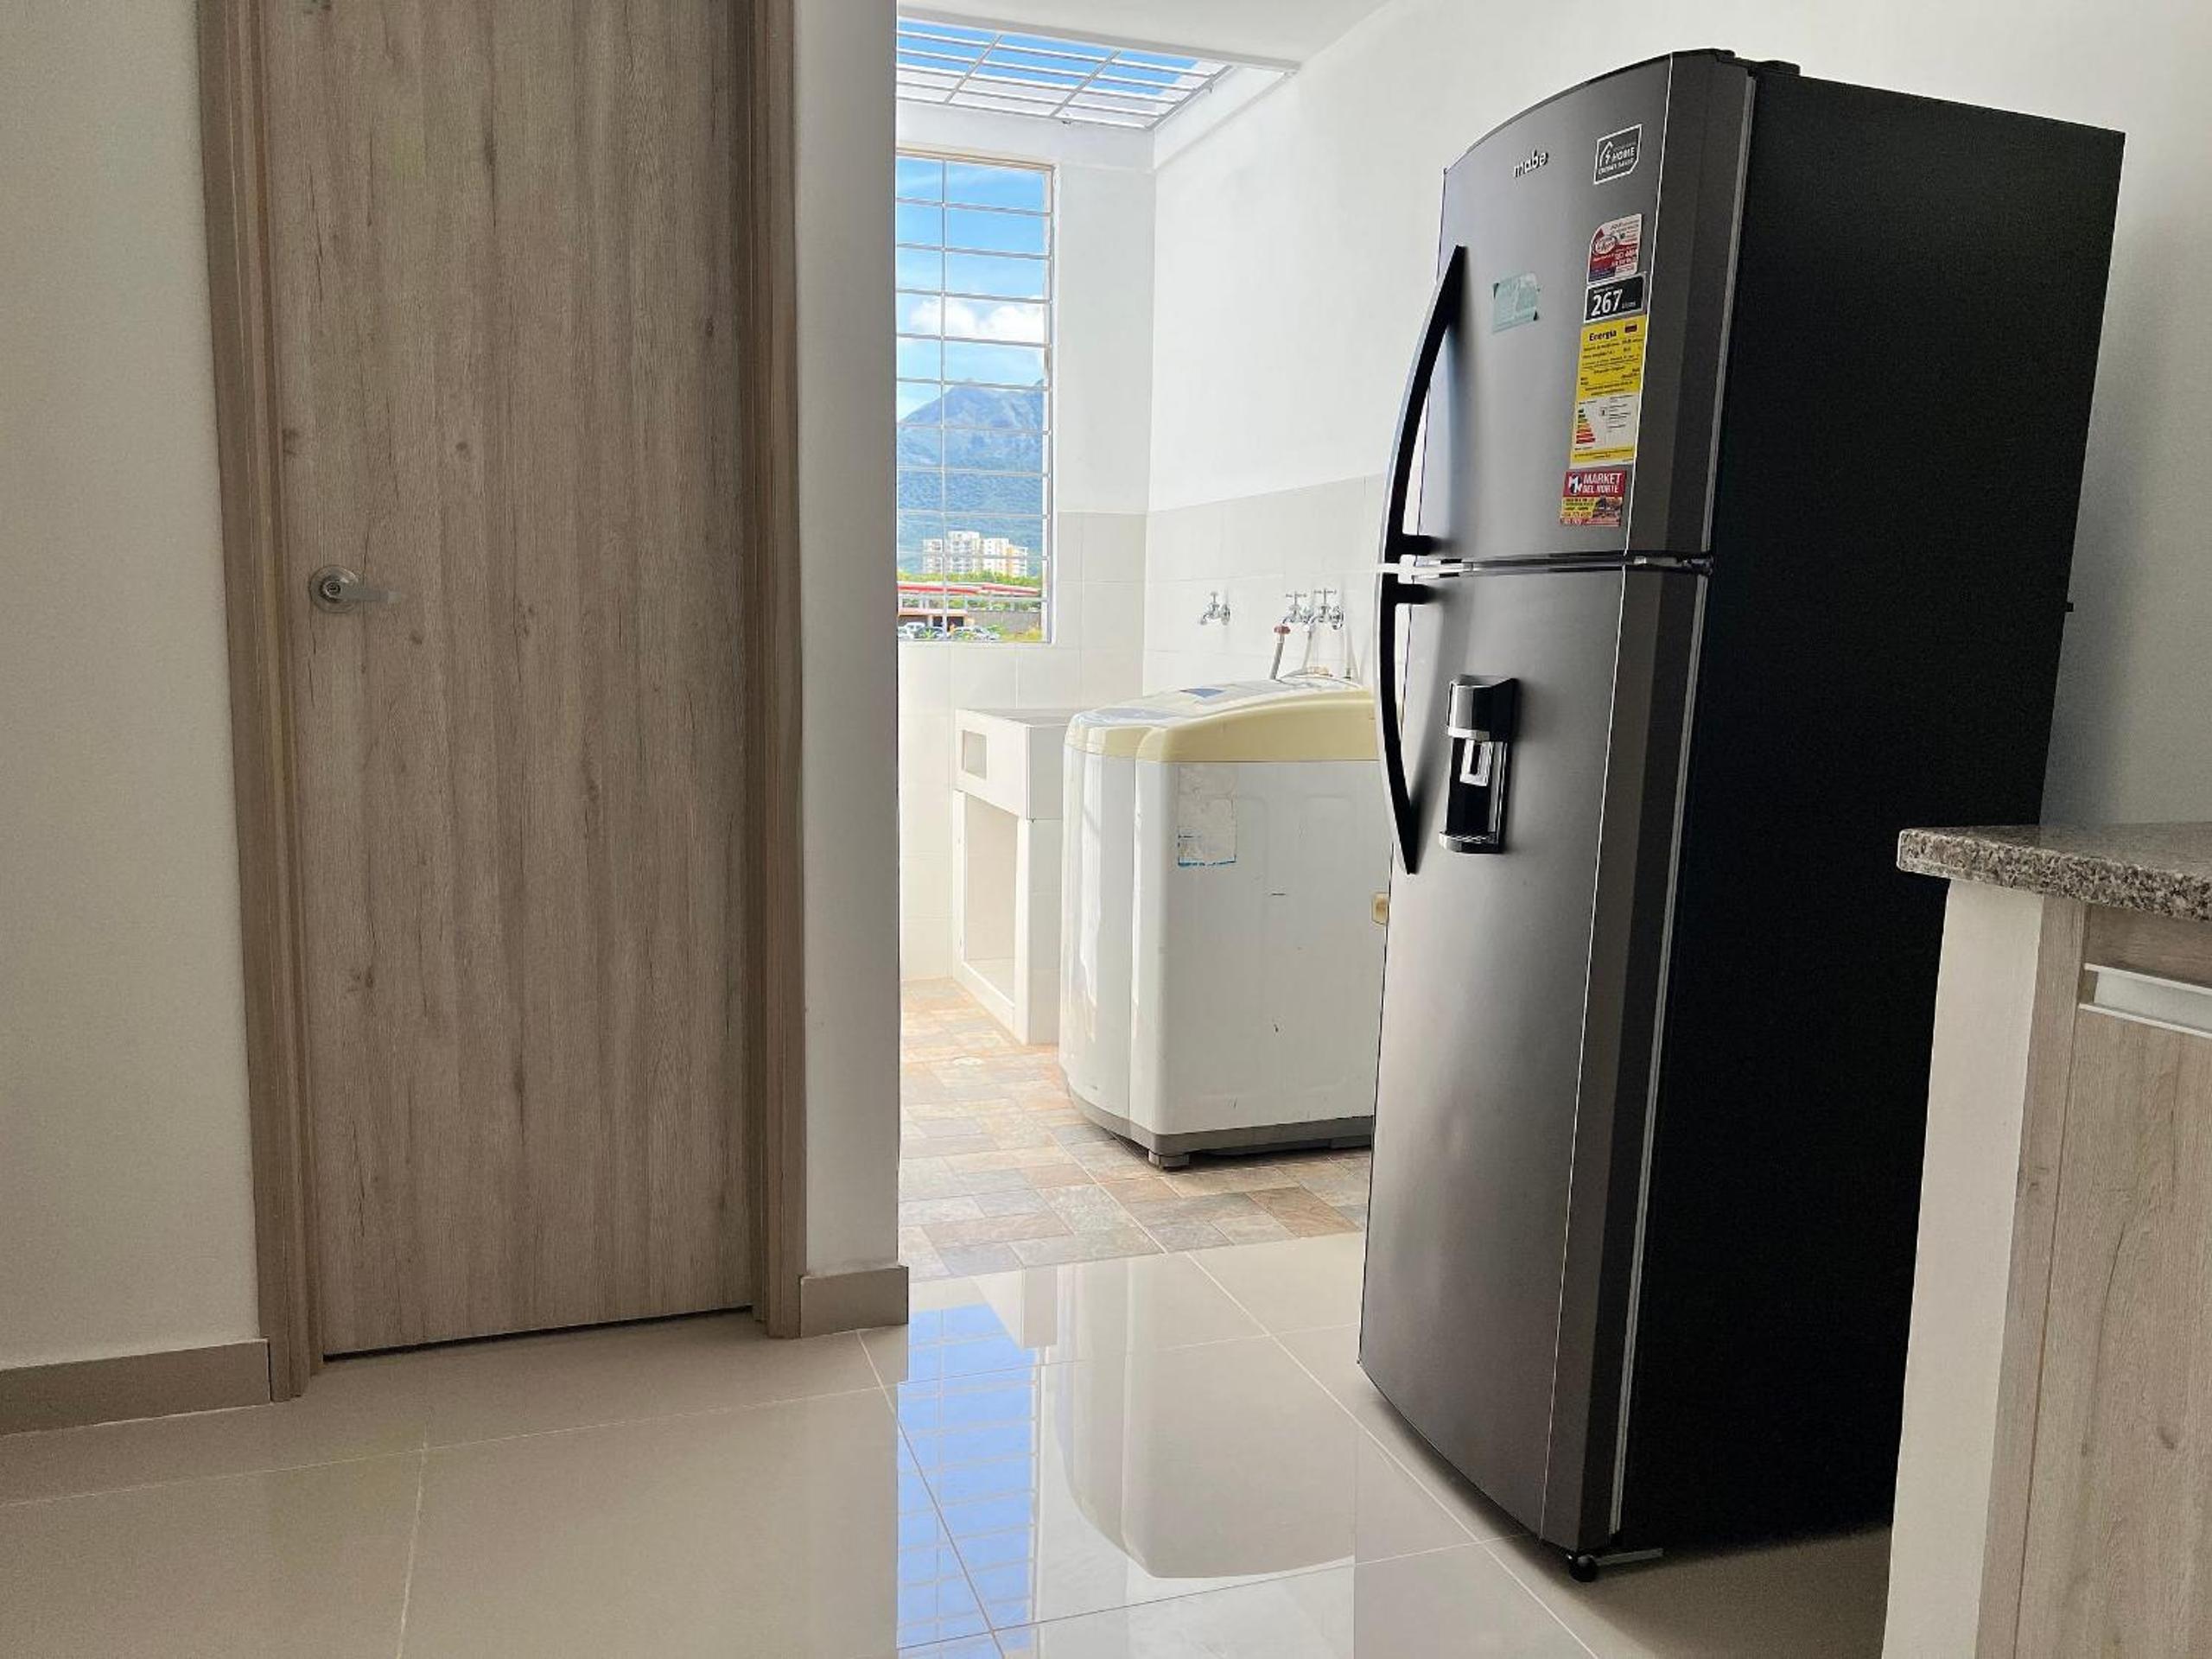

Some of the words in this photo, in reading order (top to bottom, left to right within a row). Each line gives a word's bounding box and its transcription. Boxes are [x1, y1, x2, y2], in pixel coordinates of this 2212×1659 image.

[1514, 148, 1548, 177] mabe
[1591, 289, 1623, 316] 267
[1583, 473, 1622, 485] MARKET
[1597, 484, 1618, 493] NORTE
